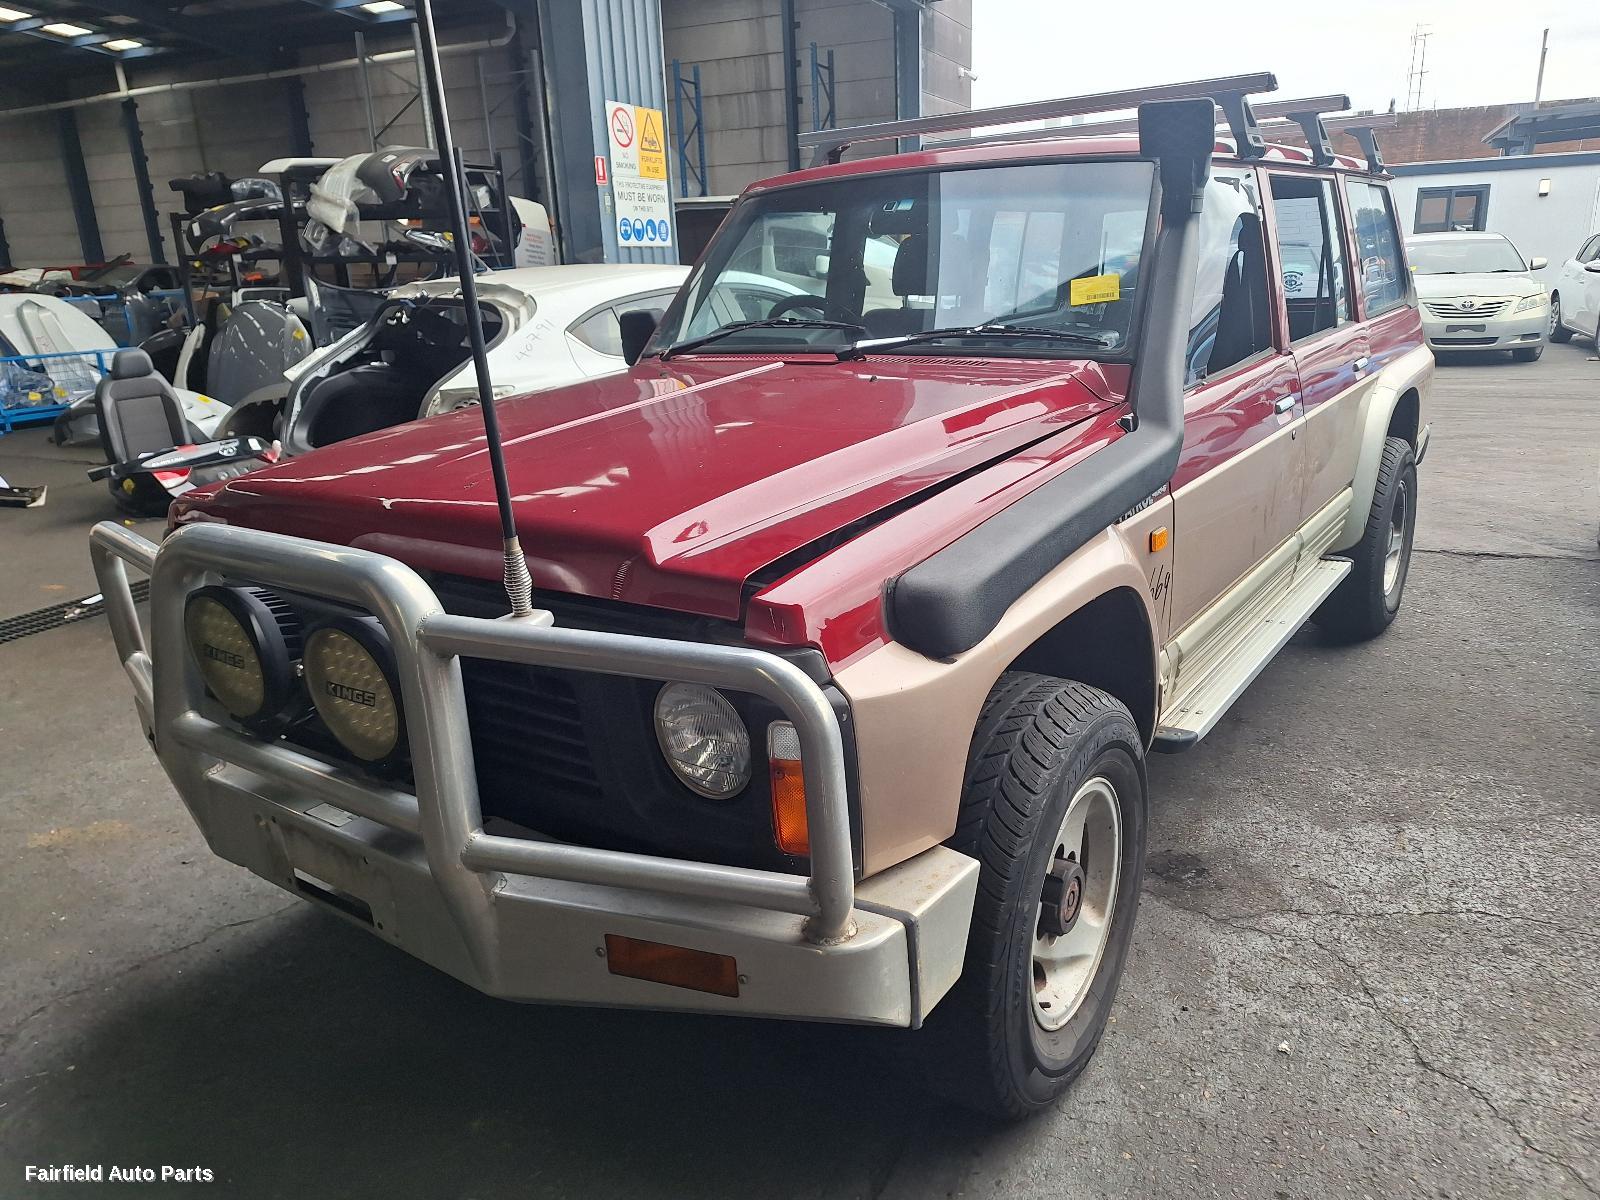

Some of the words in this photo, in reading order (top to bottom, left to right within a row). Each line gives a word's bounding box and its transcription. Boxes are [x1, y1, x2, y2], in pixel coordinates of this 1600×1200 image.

[641, 155, 663, 164] FORKLIFTS
[616, 162, 636, 170] SMOKING
[617, 191, 635, 201] MUST
[637, 192, 646, 202] BE
[647, 193, 666, 203] WORN
[515, 319, 556, 361] 40791
[326, 682, 376, 707] KINGS
